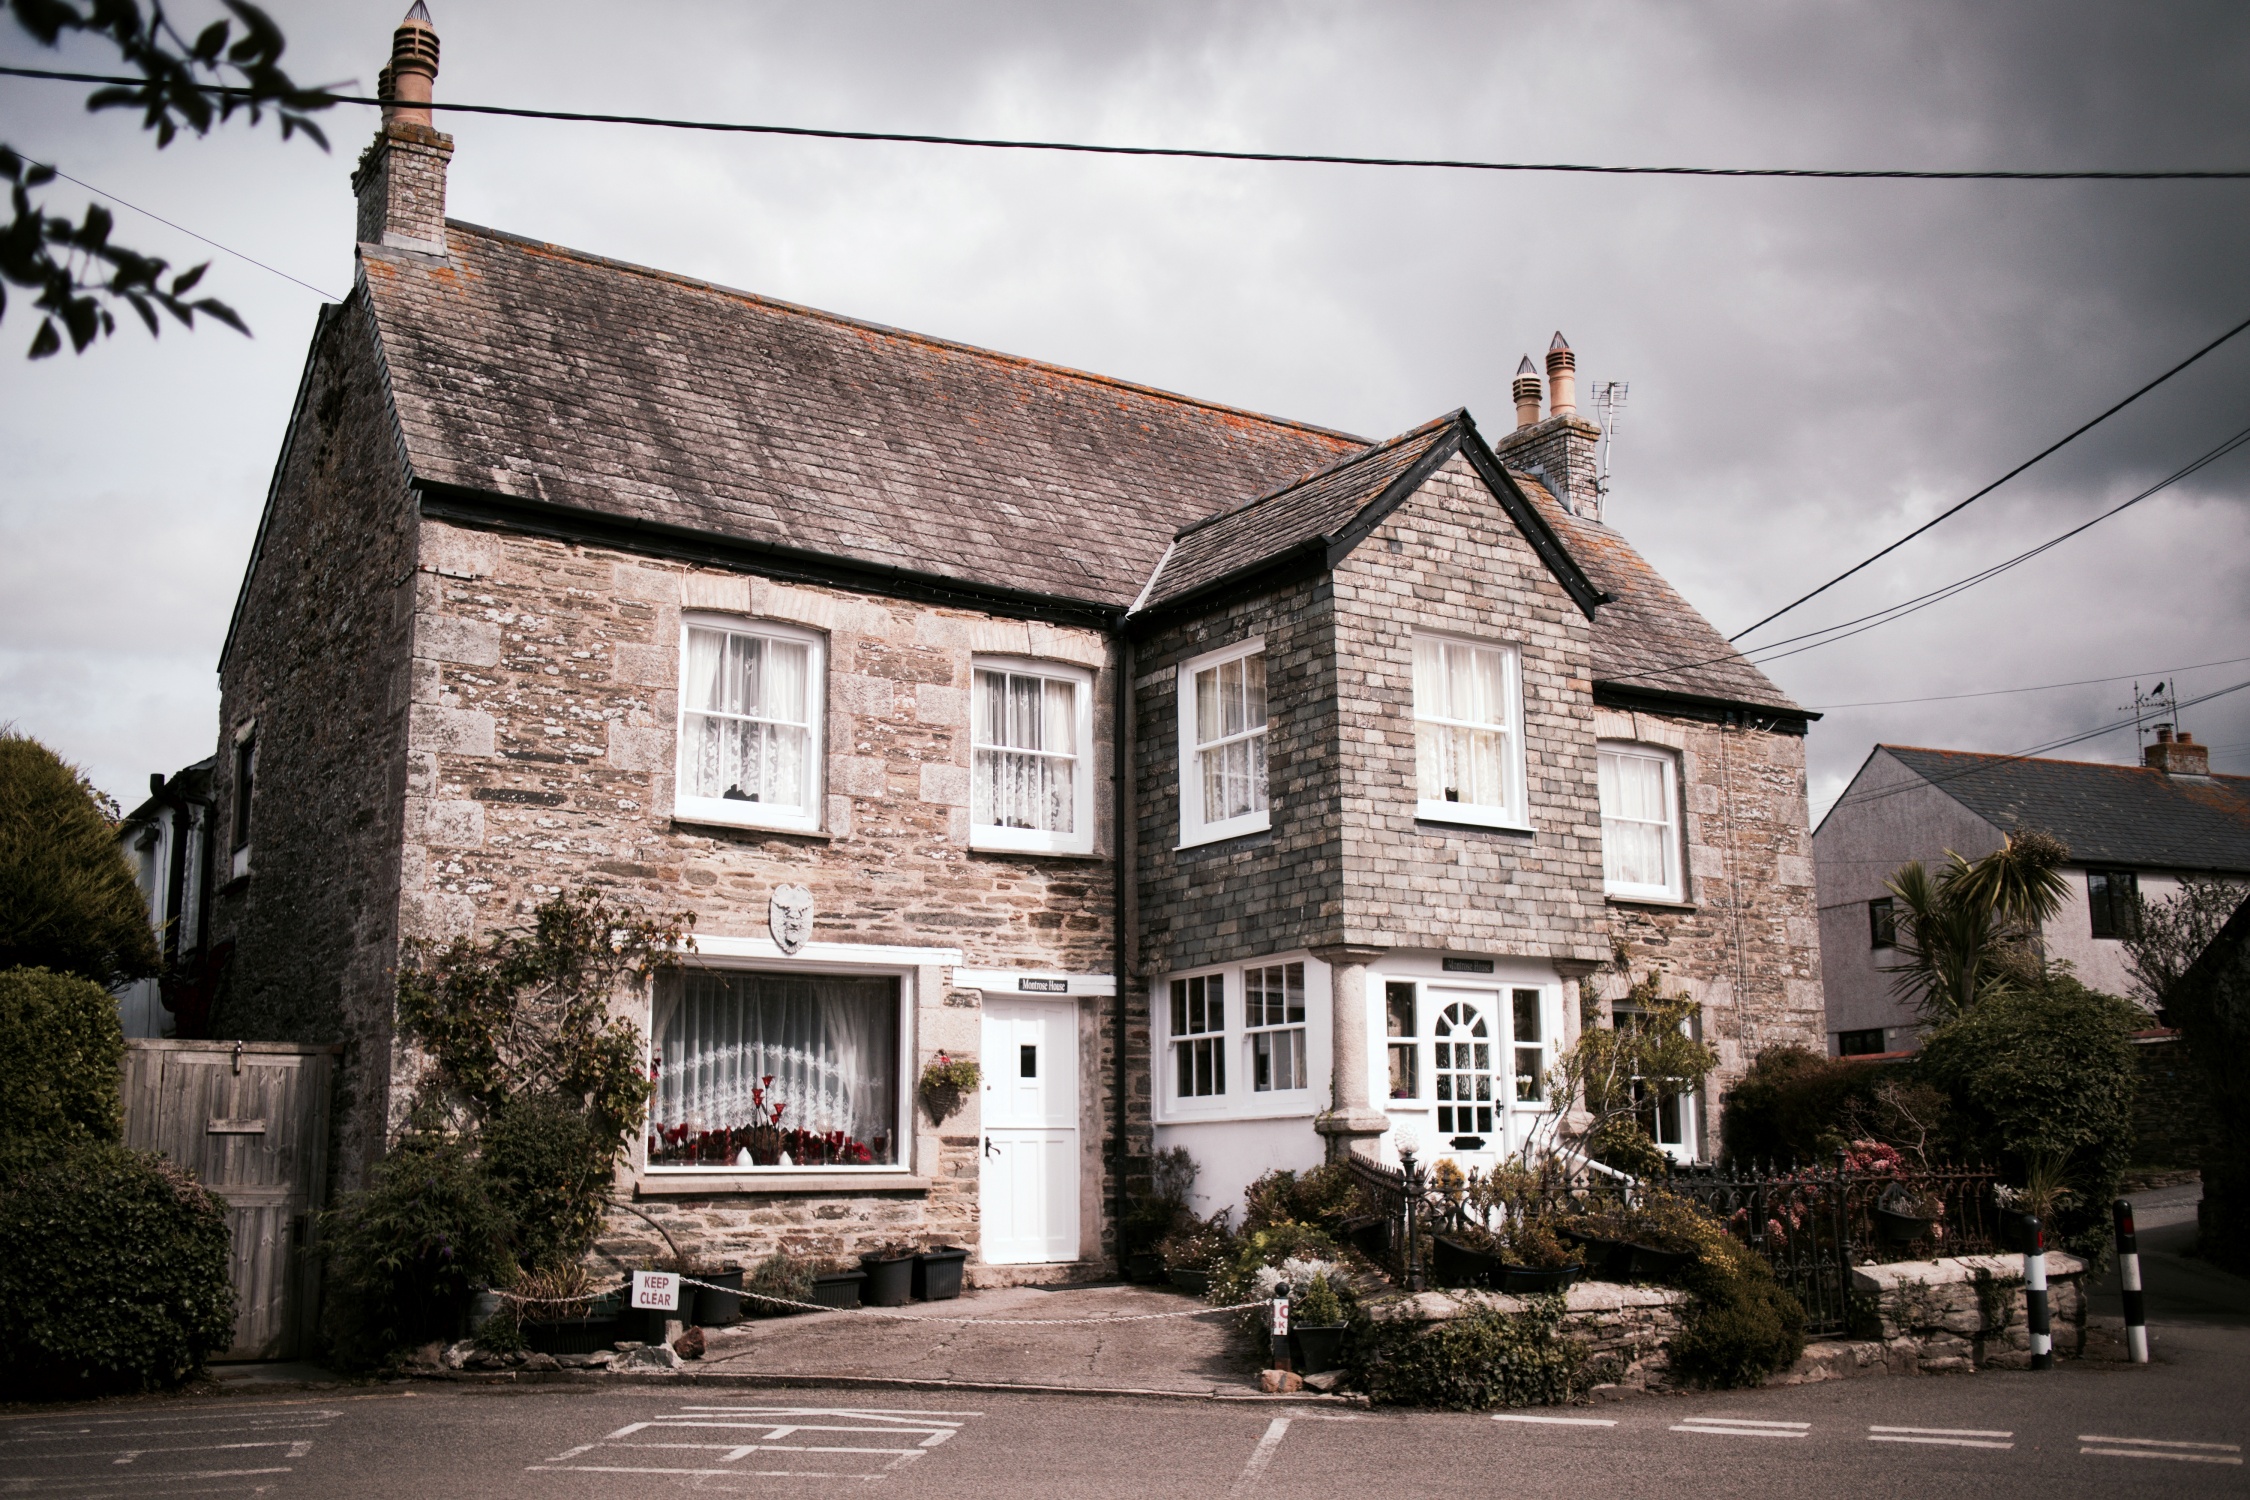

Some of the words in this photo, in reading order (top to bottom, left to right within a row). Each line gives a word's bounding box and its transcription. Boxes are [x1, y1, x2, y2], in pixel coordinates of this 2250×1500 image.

[1448, 959, 1473, 971] Montrose
[1473, 960, 1490, 972] House
[1022, 978, 1048, 990] Montrose
[1048, 980, 1065, 991] House
[644, 1276, 669, 1289] KEEP
[640, 1291, 671, 1306] CLEAR
